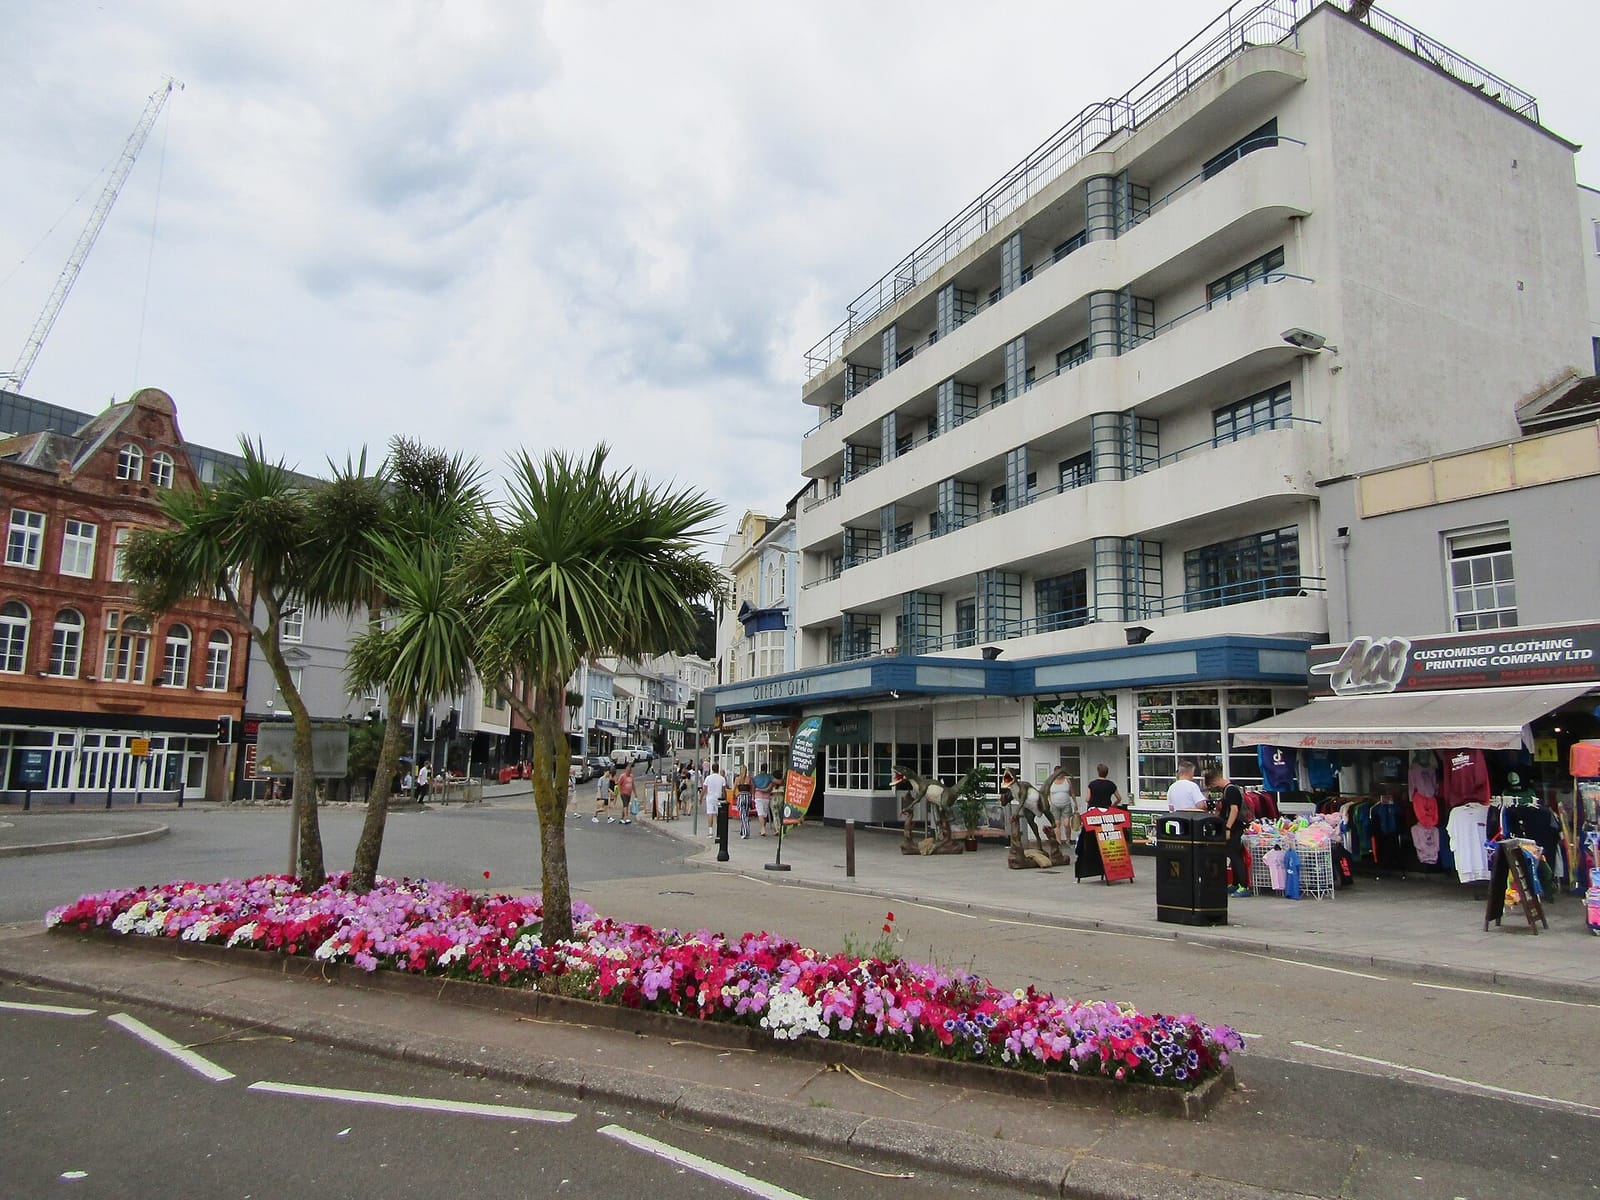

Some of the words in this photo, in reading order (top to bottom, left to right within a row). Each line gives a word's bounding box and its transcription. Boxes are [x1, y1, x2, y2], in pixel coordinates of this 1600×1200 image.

[1413, 645, 1495, 660] CUSTOMISED
[1499, 638, 1573, 653] CLOTHING
[1425, 657, 1487, 670] PRINTING
[1490, 651, 1562, 665] COMPANY
[1565, 649, 1592, 660] LTD
[788, 679, 810, 695] QUAY
